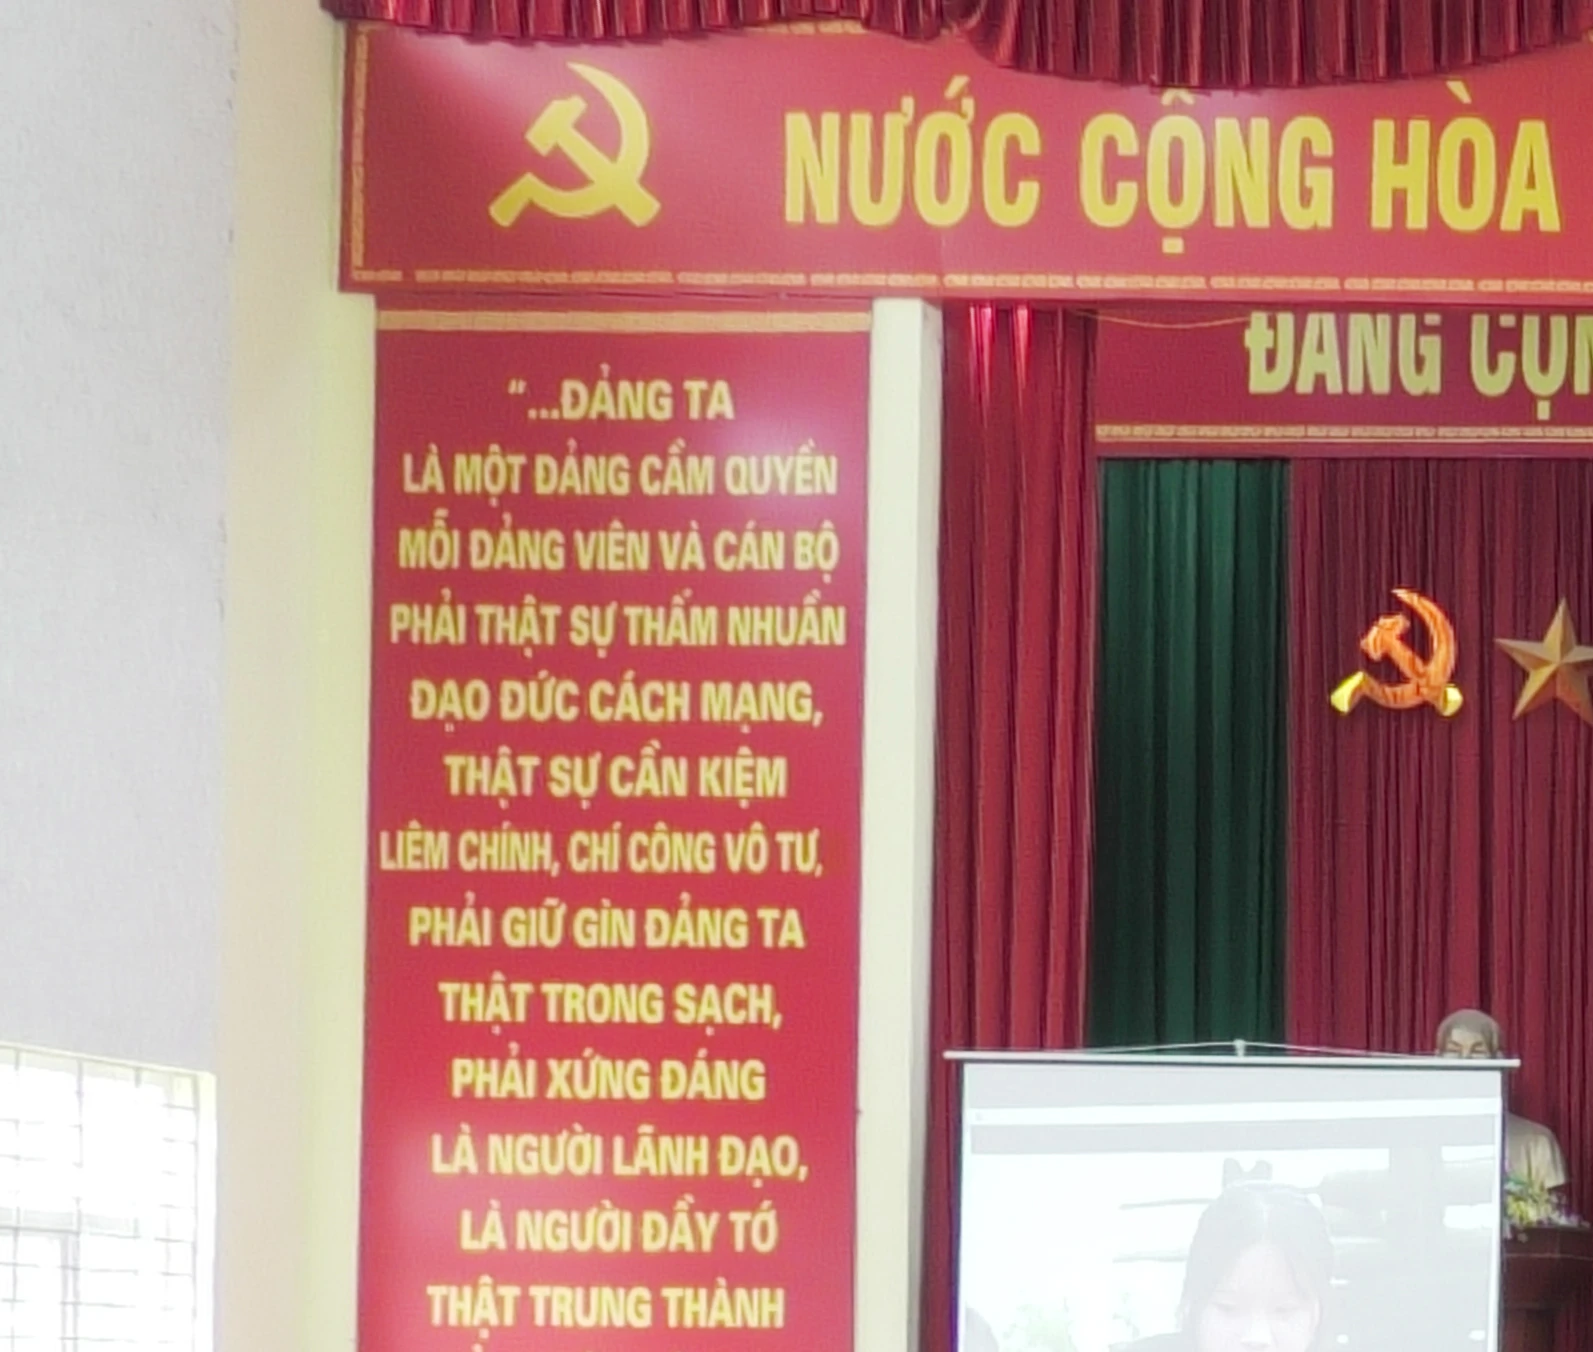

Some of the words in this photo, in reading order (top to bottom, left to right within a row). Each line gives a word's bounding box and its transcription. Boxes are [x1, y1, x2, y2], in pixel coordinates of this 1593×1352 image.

[785, 75, 1041, 229] NƯỚC
[1080, 90, 1333, 254] CỘNG
[1371, 79, 1560, 232] HÒA
[684, 380, 735, 420] TA
[399, 508, 460, 569] MỖI
[469, 513, 565, 570] ĐẢNG
[574, 520, 650, 571] VIÊN
[659, 521, 705, 570] VÀ
[714, 520, 785, 571] CÁN
[793, 520, 839, 582] BỘ
[390, 588, 466, 644] PHẢI
[475, 594, 561, 657] THẬT
[570, 602, 617, 657] SỰ
[623, 589, 719, 646] THẤM
[728, 589, 845, 646] NHUẦN
[380, 820, 450, 870] LIÊM
[458, 822, 559, 876] CHÍNH,
[568, 822, 621, 872] CHÍ
[627, 822, 715, 873] CÔNG
[724, 822, 769, 873] VÔ
[776, 829, 822, 876] TƯ,
[439, 972, 534, 1034] THẬT
[541, 983, 664, 1024] TRONG
[674, 983, 781, 1035] SẠCH,
[452, 1042, 537, 1099] PHẢI
[546, 1048, 651, 1100] XỨNG
[659, 1049, 765, 1100] ĐÁNG
[431, 1124, 479, 1176] LÀ
[487, 1124, 603, 1177] NGƯỜI
[612, 1124, 709, 1176] LÃNH
[717, 1135, 808, 1188] ĐẠO,
